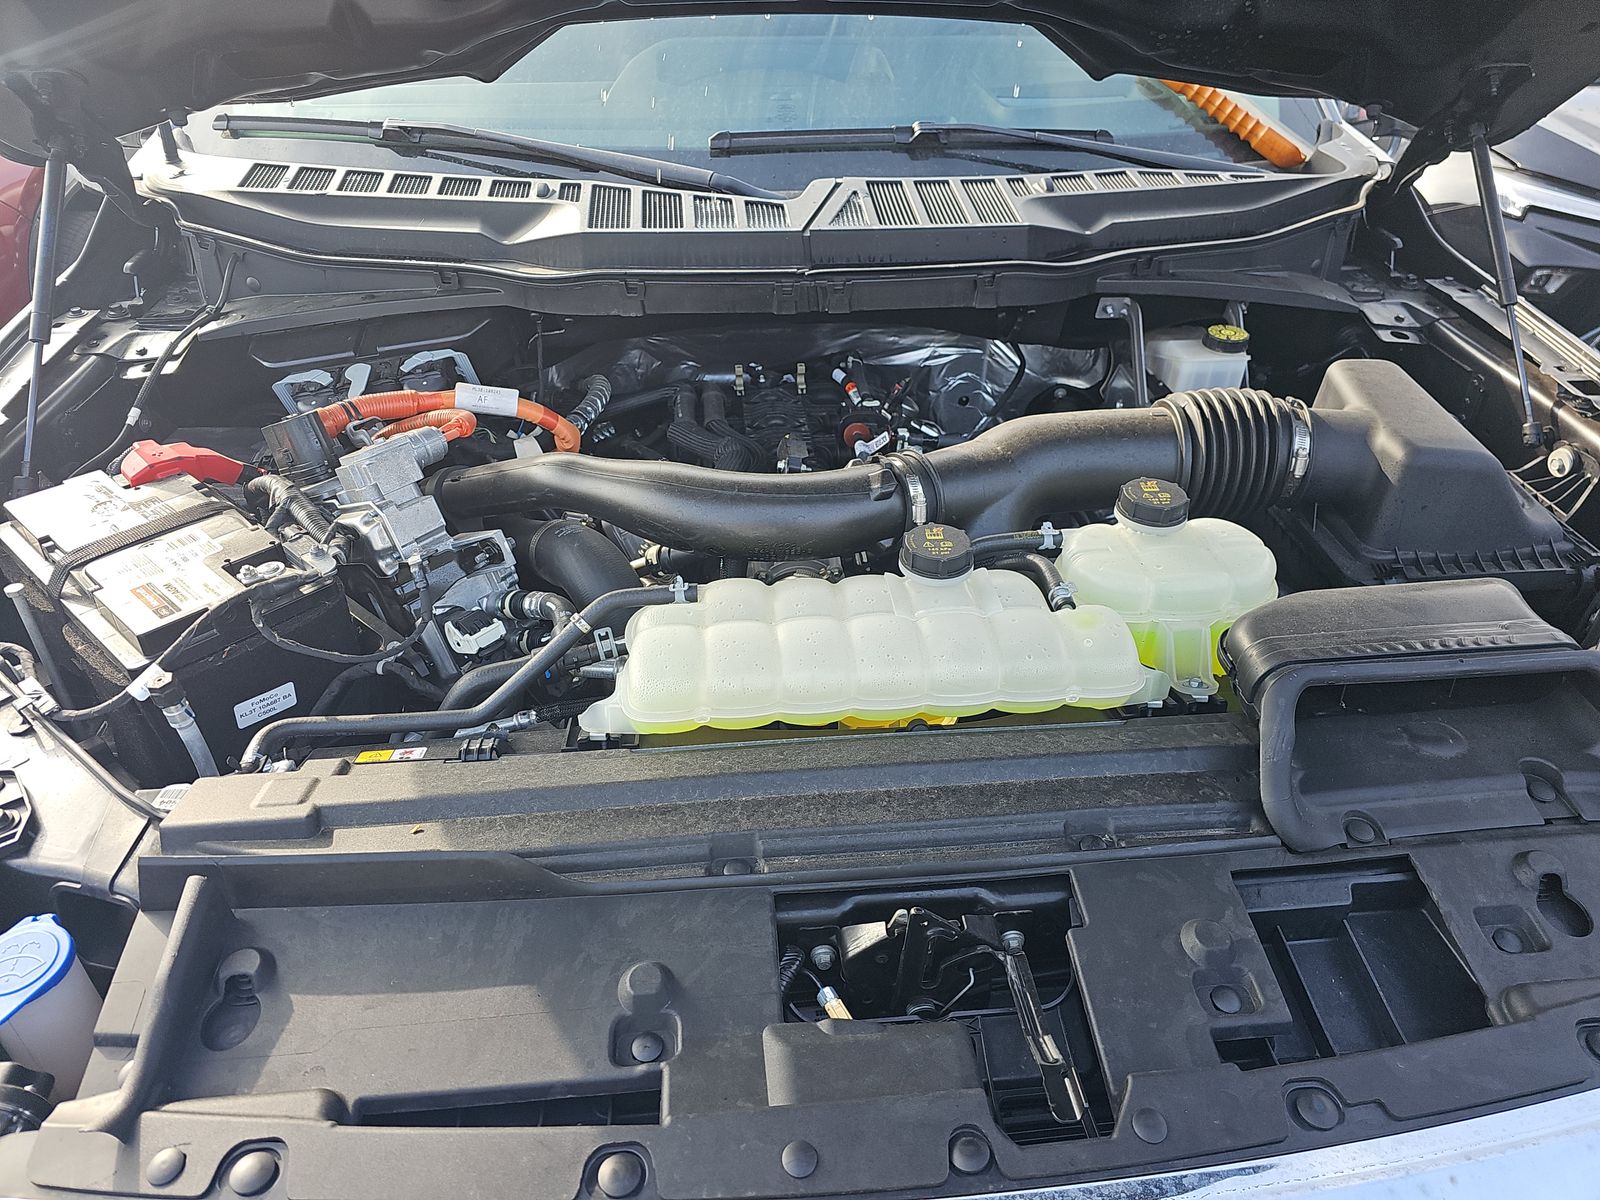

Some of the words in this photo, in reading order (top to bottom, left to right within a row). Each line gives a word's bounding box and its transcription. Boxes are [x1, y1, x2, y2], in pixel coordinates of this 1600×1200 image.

[477, 395, 488, 404] AF
[251, 692, 279, 707] FoMoCo
[240, 708, 256, 718] KL3T
